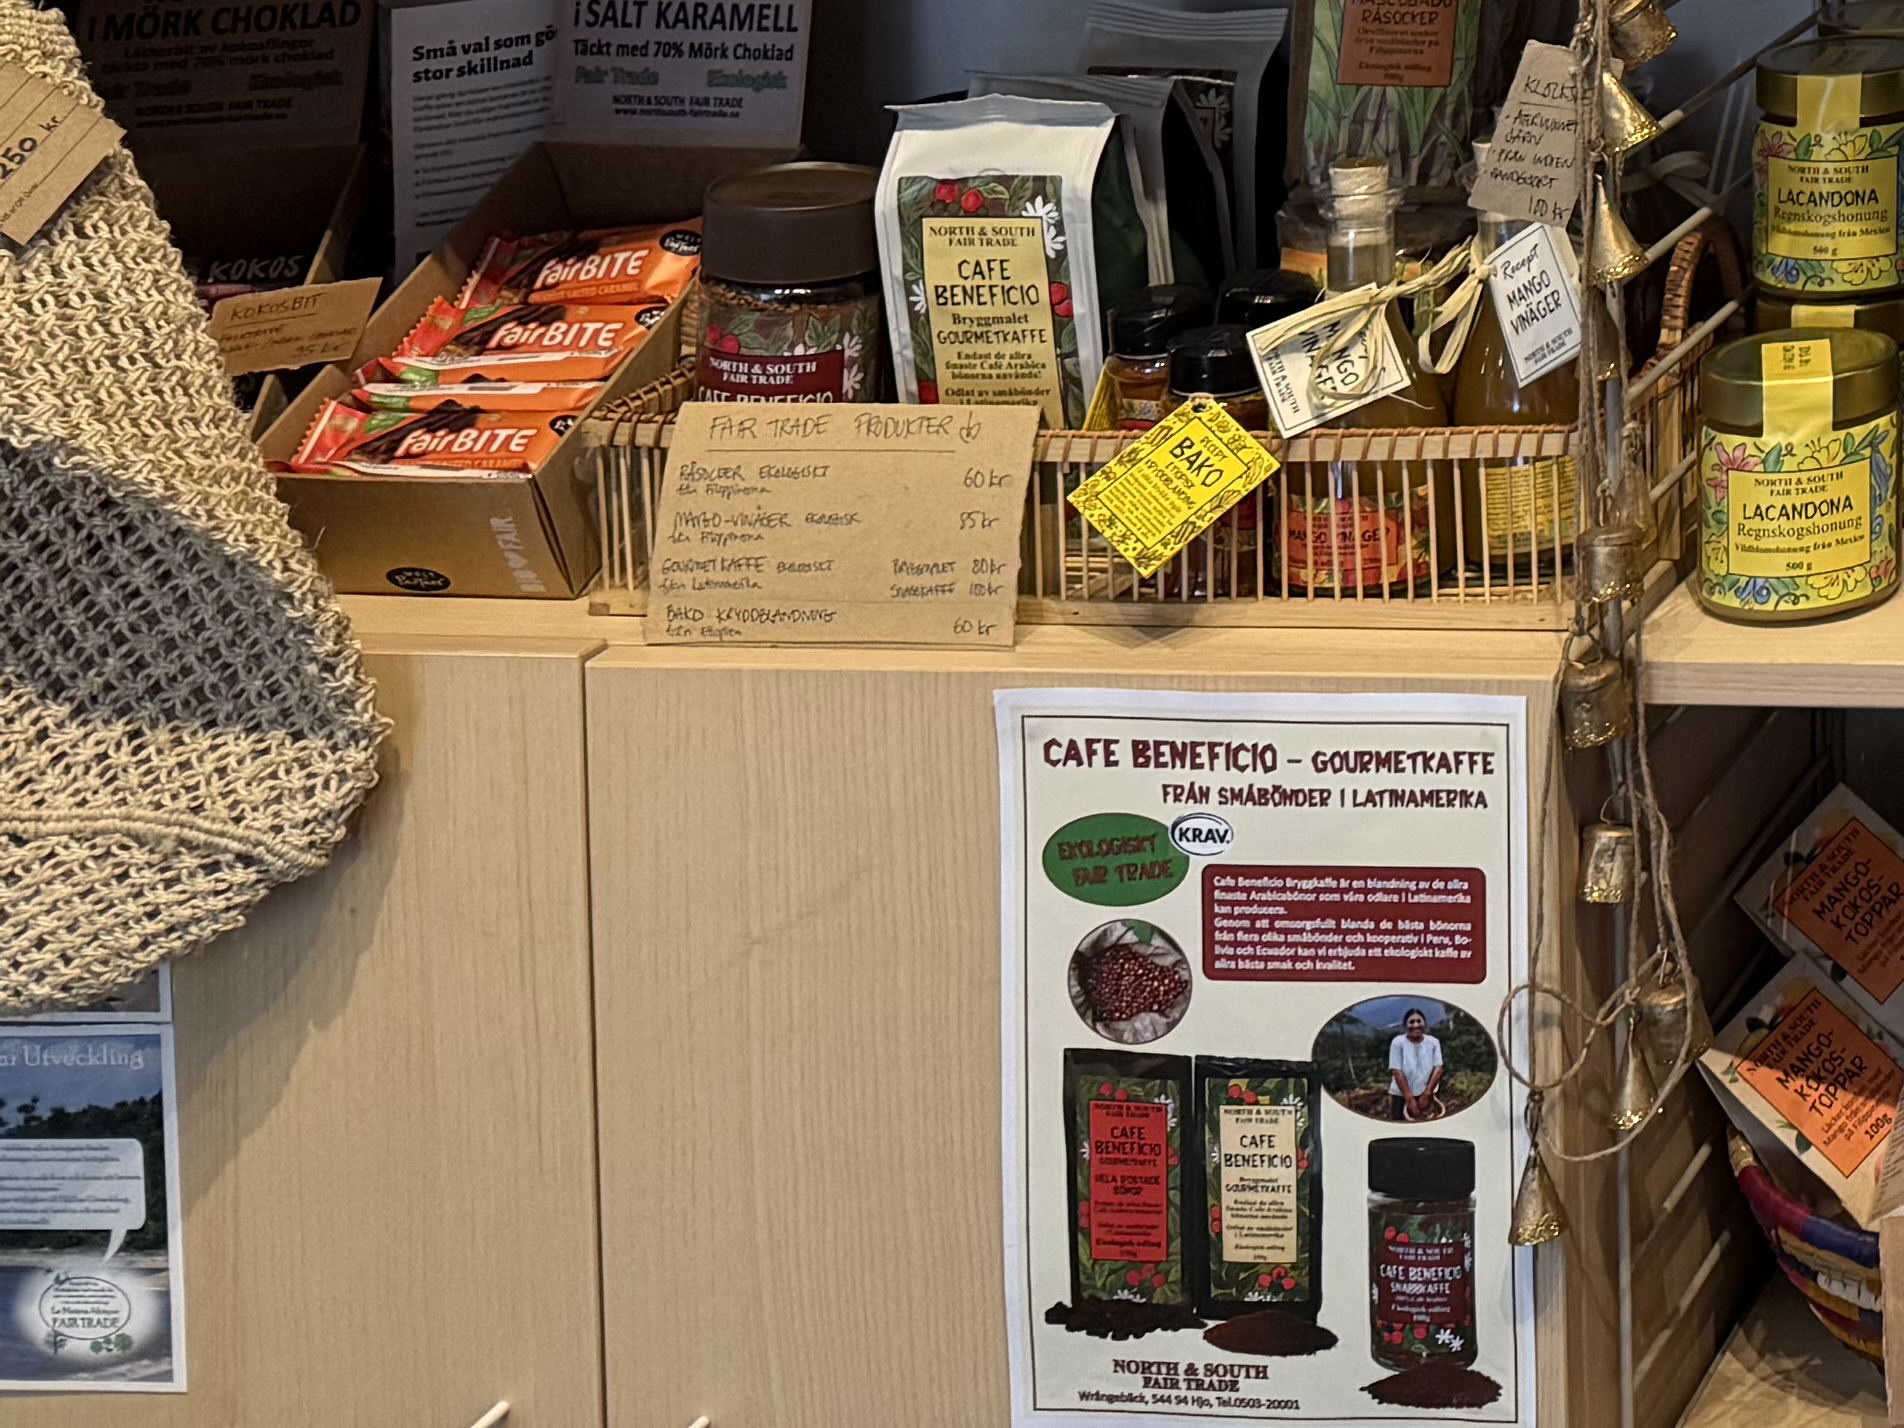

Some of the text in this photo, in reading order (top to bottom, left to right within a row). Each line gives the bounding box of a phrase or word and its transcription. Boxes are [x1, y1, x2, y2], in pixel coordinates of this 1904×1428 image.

[103, 4, 204, 42] MÖRK
[584, 0, 799, 36] SALT KARAMELL
[411, 49, 536, 85] stor skillnad
[398, 424, 536, 455] fairBITE
[708, 411, 766, 441] FAIR
[771, 412, 850, 441] TRADE
[1167, 432, 1225, 493] BAKO
[1741, 494, 1855, 523] LACANDONA
[1736, 515, 1863, 539] Regnskogshonung
[1042, 737, 1497, 777] CAFE BENEFICIO GOURMETKAFFE
[1161, 781, 1490, 811] FRÅN SMÅBÖNDER LATINAMERIKA
